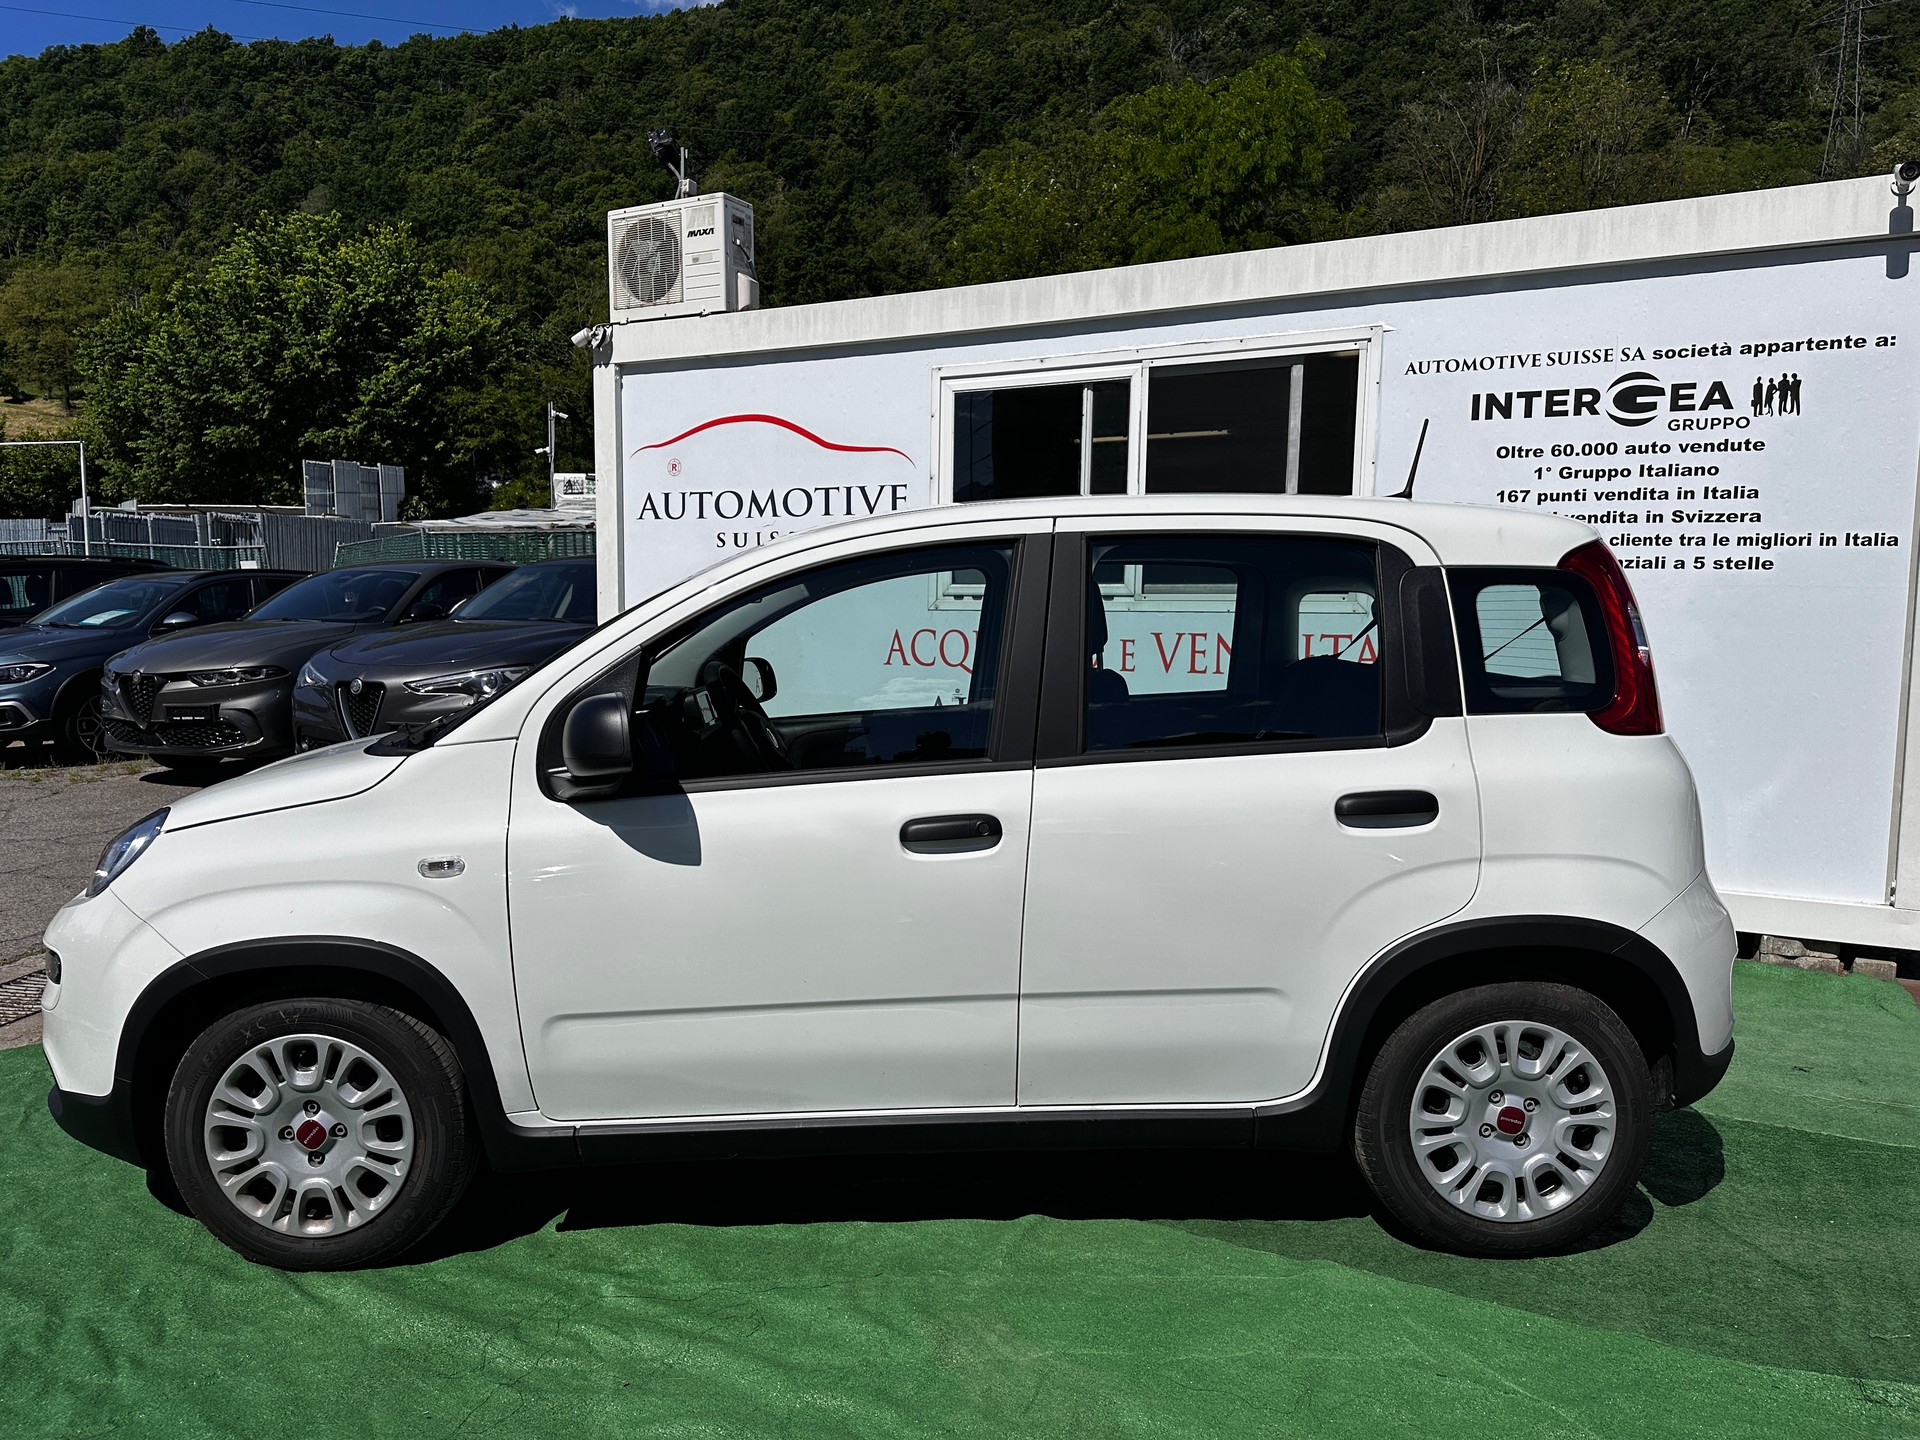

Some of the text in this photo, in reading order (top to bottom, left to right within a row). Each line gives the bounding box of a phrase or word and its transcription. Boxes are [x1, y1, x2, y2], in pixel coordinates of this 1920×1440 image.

[1404, 335, 1897, 376] AUTOMOTIVE SUISSE SA società appartente a:
[1667, 416, 1750, 432] GRUPPO
[1496, 438, 1766, 459] Oltre 60.000 auto vendute
[1558, 467, 1632, 481] Gruppo
[1639, 464, 1720, 478] Italiano
[636, 483, 908, 520] AUTOMOTIVE
[1496, 485, 1760, 505] 167 punti vendita in Italia
[1645, 511, 1664, 524] in
[1671, 510, 1762, 523] Svizzera
[1609, 533, 1899, 550] cliente tra le migliori in Italia
[1673, 561, 1686, 570] a
[1693, 557, 1706, 570] 5
[1713, 556, 1775, 570] stelle
